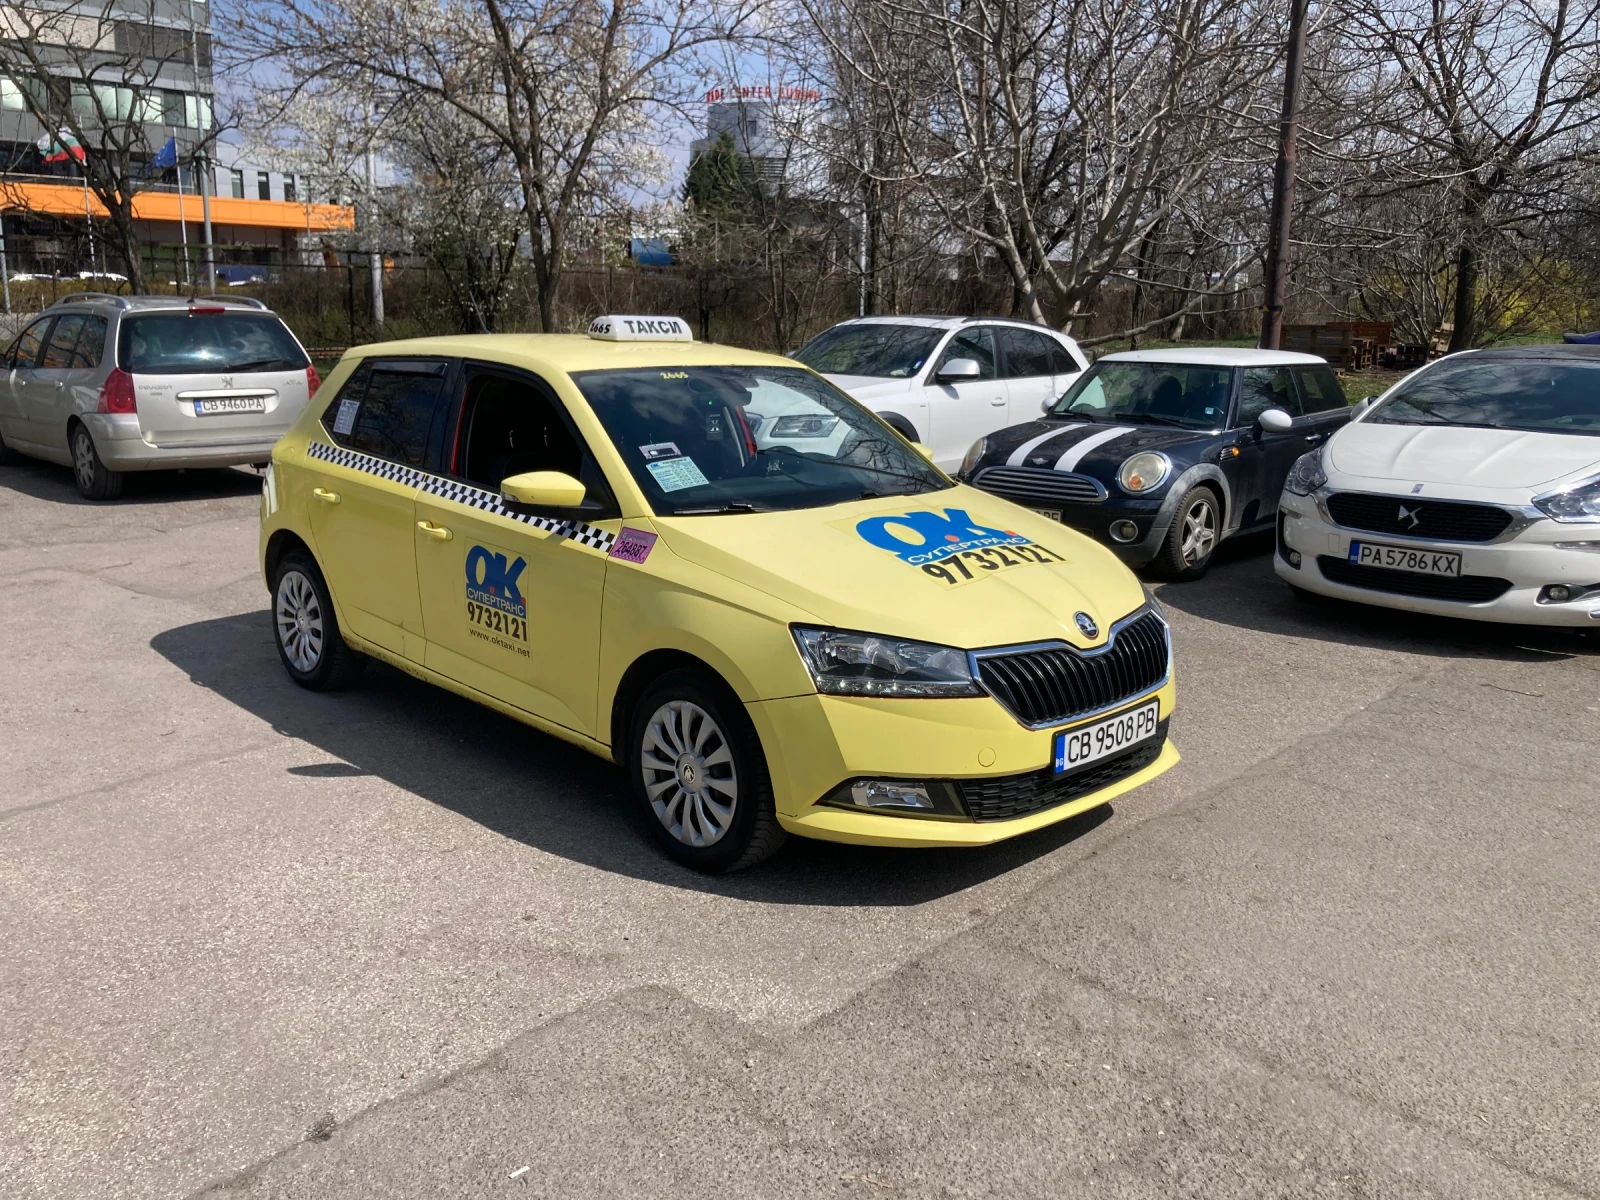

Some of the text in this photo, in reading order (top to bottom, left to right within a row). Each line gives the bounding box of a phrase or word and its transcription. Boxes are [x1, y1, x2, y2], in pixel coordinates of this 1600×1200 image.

[624, 320, 682, 334] ТАКСИ
[203, 400, 219, 411] CB
[220, 399, 246, 410] 9460
[248, 398, 263, 409] PA
[907, 536, 1027, 564] СУПЕРТРАНС
[921, 544, 1067, 585] 9732121
[1361, 546, 1456, 574] PA 5786 KX
[467, 587, 525, 617] СУПЕРТРАНС
[467, 601, 528, 642] 9732121
[469, 628, 531, 658] www.oktaxi.net
[1068, 707, 1155, 763] CB 9508 PB
[1056, 758, 1064, 768] BG
